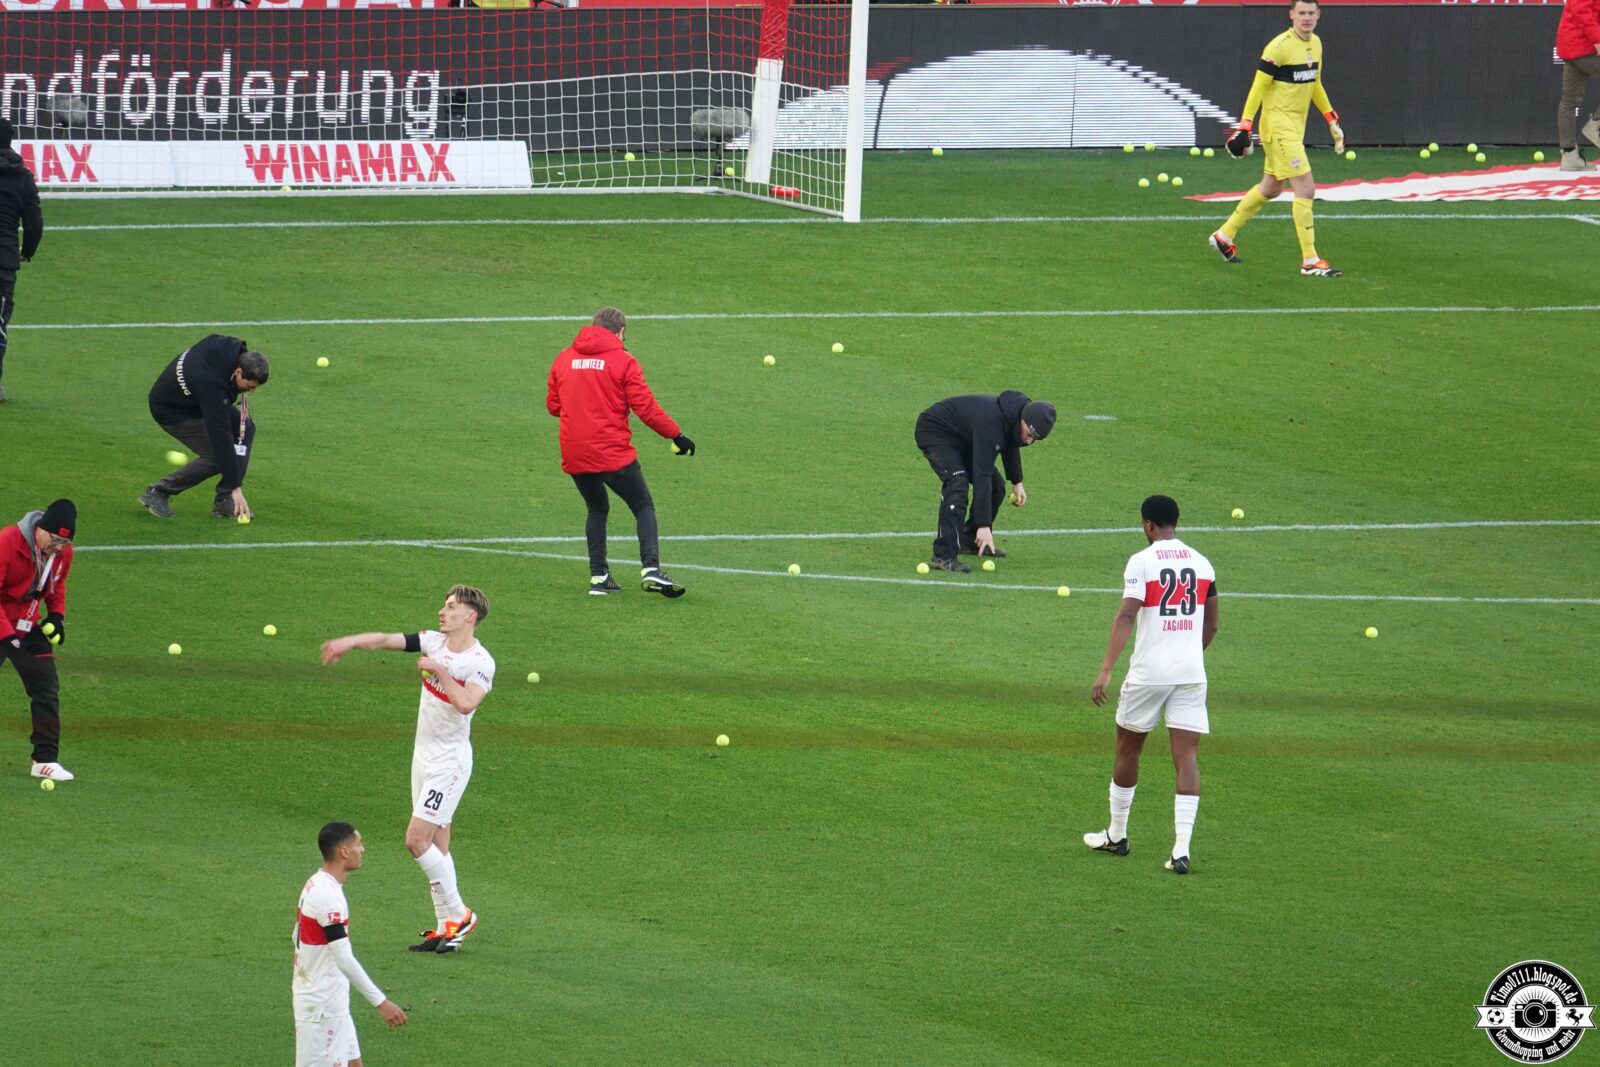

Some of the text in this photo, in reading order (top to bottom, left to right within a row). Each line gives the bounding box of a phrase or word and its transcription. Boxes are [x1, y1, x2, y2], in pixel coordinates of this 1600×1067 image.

[243, 143, 456, 183] WINAMAX
[571, 358, 605, 371] VOLUNTEER
[1156, 549, 1191, 560] STUTTGART
[1159, 567, 1197, 617] 23
[423, 788, 444, 811] 29
